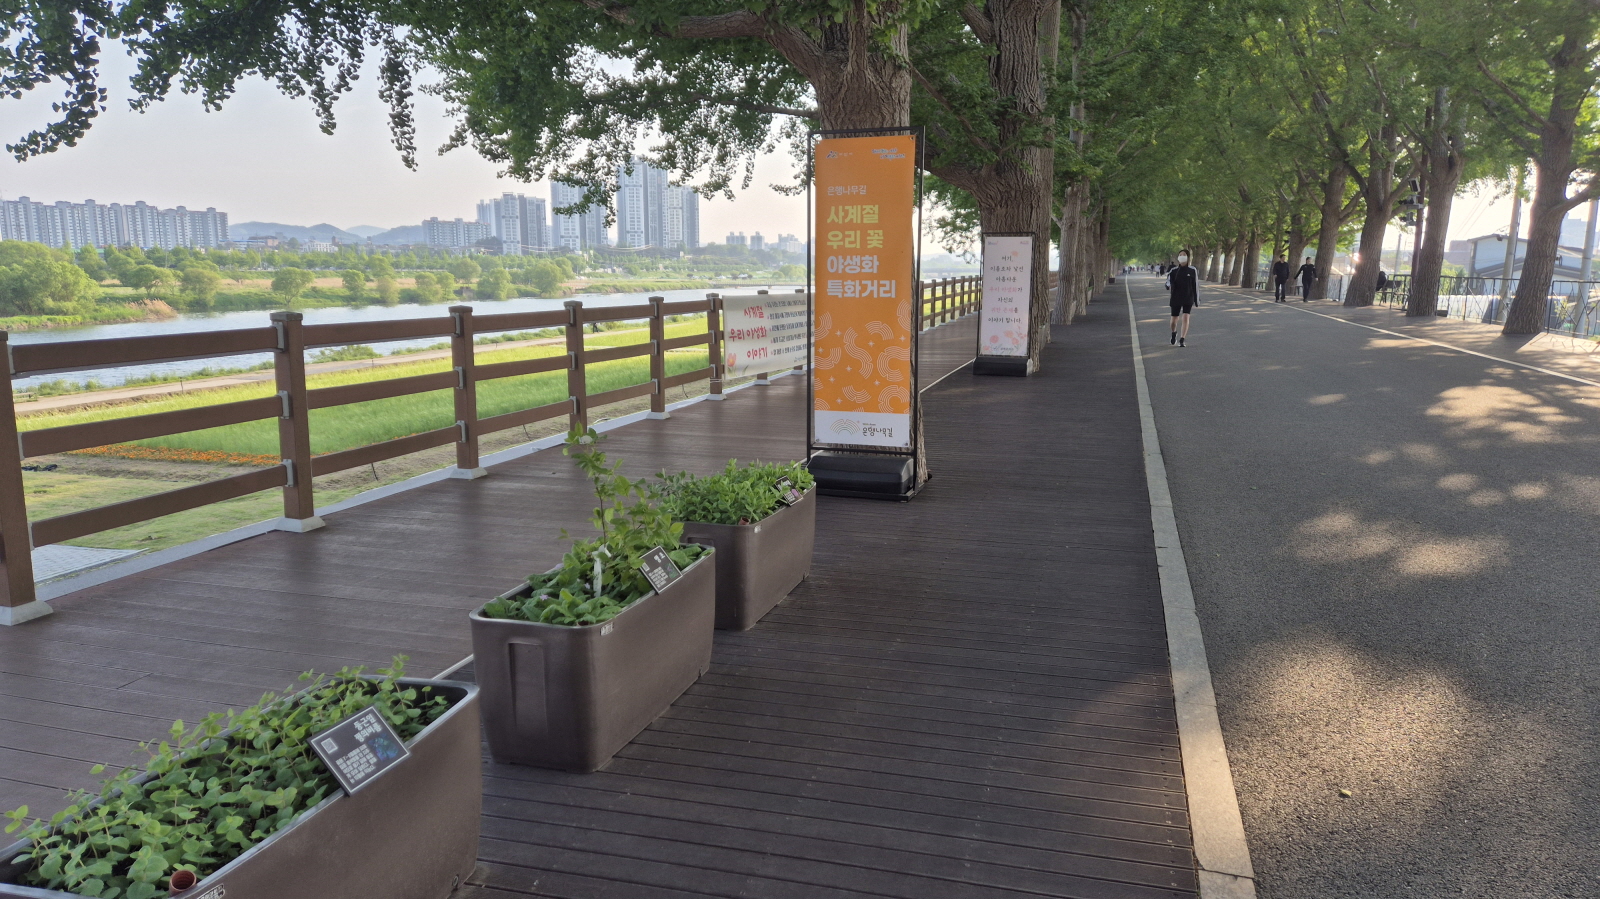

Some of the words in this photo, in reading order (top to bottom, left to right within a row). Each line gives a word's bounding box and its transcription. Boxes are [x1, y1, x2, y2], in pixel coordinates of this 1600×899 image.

[827, 185, 867, 196] 은행나무길
[827, 205, 879, 224] 사계절
[827, 230, 861, 249] 우리
[866, 230, 884, 249] 꽃
[827, 255, 880, 274] 야생화
[827, 280, 897, 298] 특화거리
[743, 305, 765, 319] 사계절
[729, 328, 745, 342] 우리
[746, 325, 768, 340] 야생화
[746, 346, 768, 360] 이야기
